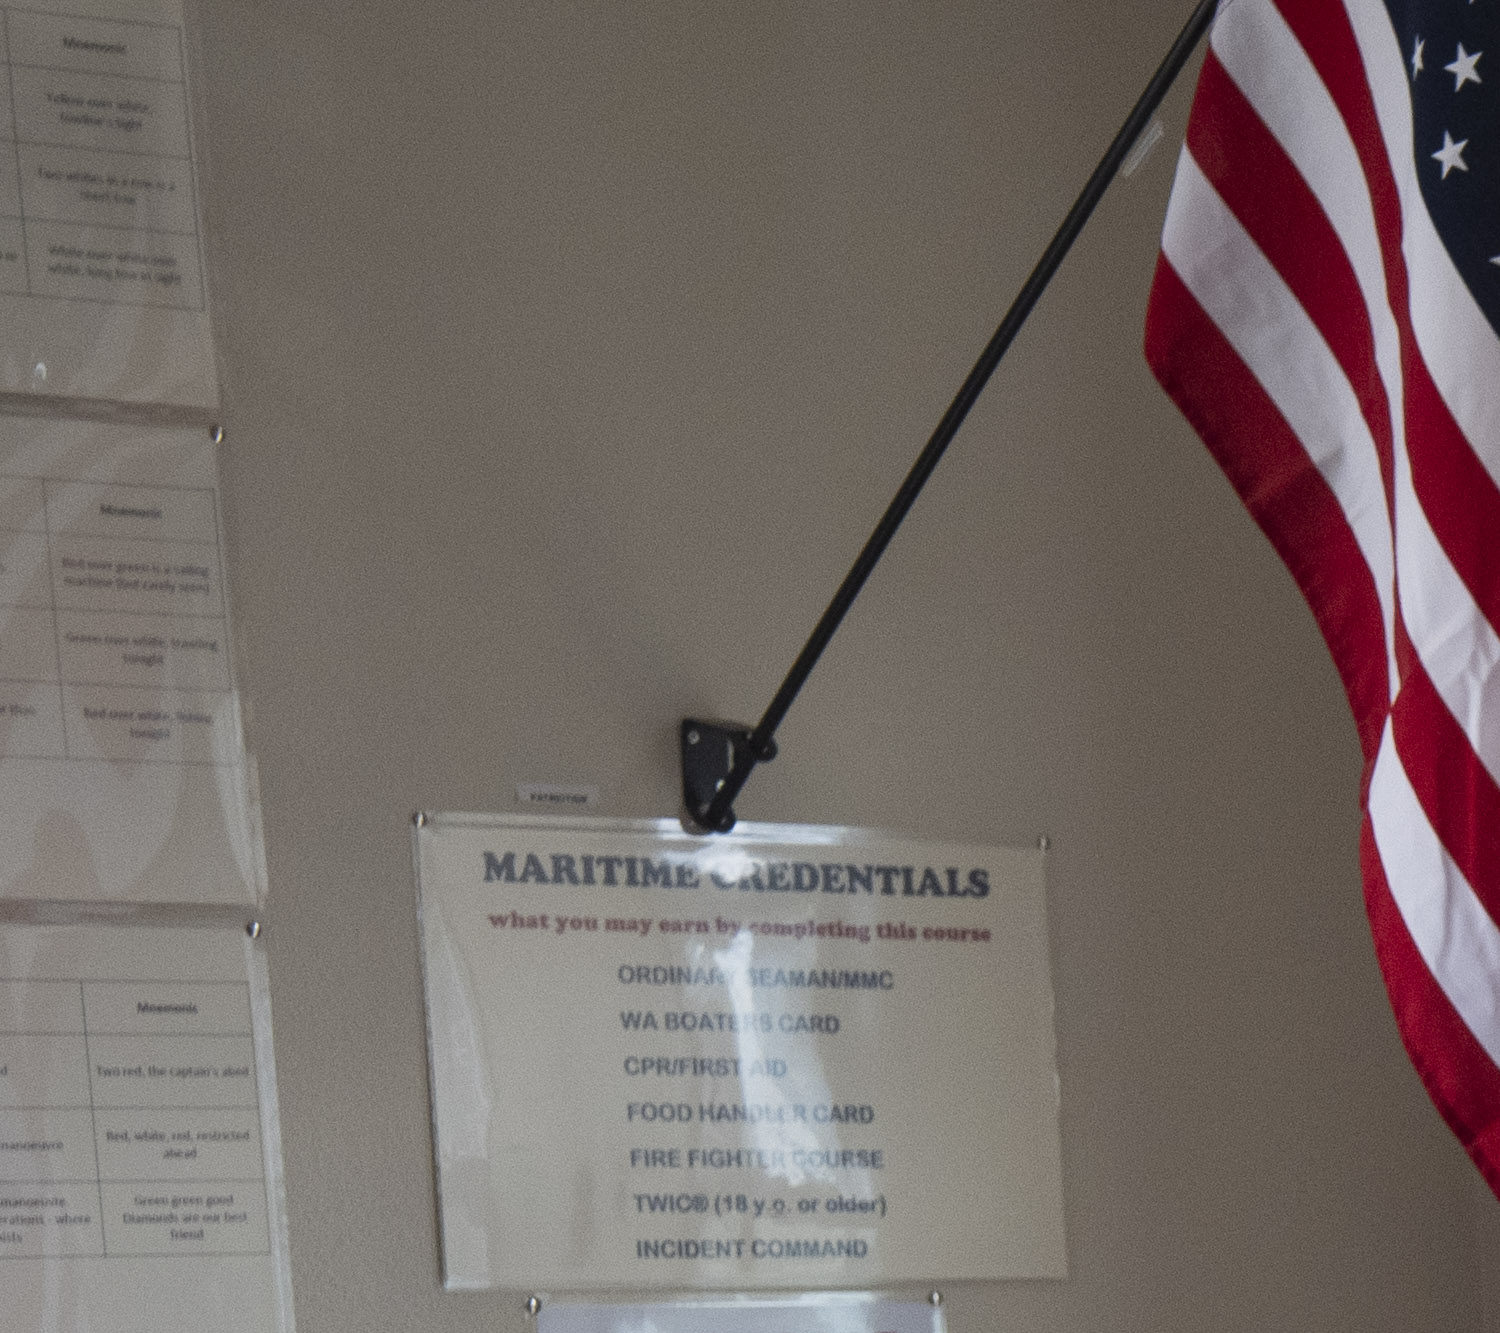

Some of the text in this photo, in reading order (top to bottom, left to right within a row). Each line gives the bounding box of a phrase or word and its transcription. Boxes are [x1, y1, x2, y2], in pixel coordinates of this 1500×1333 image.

[483, 851, 700, 889] MARITIME
[488, 911, 548, 930] what
[555, 915, 598, 935] you
[605, 916, 650, 936] may
[659, 918, 710, 934] earn
[715, 916, 742, 936] by
[876, 920, 917, 940] this
[922, 926, 991, 942] course
[617, 964, 736, 986] ORDINAR
[620, 1011, 658, 1031] WA
[778, 1014, 840, 1034] CARD
[624, 1055, 740, 1077] CPR/FIRST
[627, 1103, 693, 1123] FOOD
[813, 1104, 875, 1124] CARD
[630, 1149, 680, 1169] FIRE
[714, 1194, 749, 1217] (18
[797, 1200, 819, 1213] or
[825, 1193, 887, 1218] older)
[636, 1239, 868, 1259] INCIDENT COMMAND
